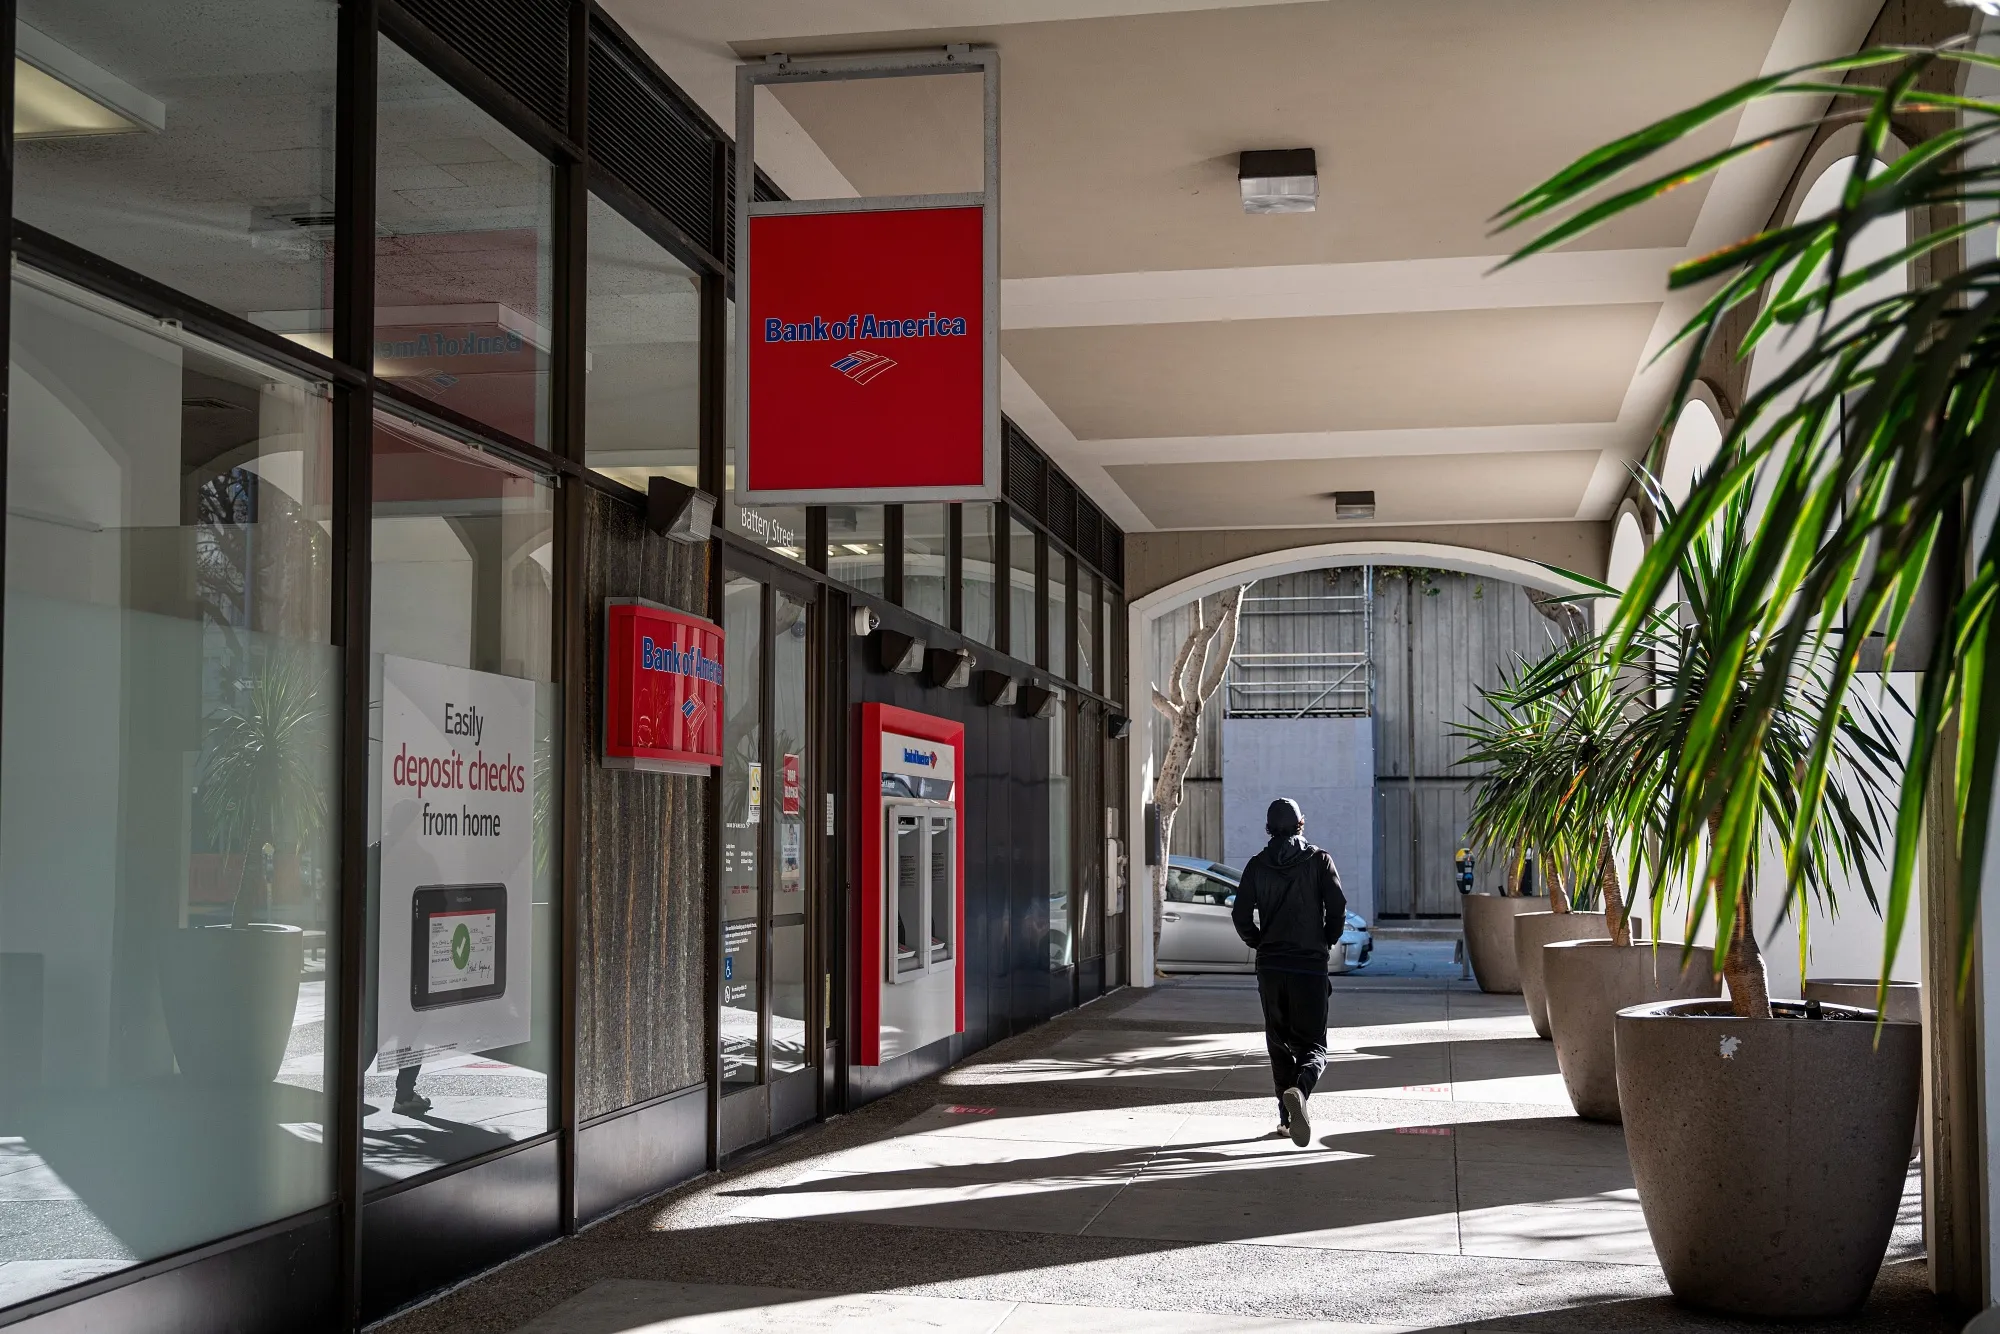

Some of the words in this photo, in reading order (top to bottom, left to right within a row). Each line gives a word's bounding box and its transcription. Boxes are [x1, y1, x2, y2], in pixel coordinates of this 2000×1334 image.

[765, 316, 829, 342] Bank
[831, 315, 859, 340] of
[860, 312, 966, 339] America
[741, 507, 770, 544] Battery
[772, 518, 795, 548] Street
[642, 635, 682, 675] Bank
[682, 646, 696, 678] of
[445, 702, 484, 746] Easily
[393, 742, 464, 798] deposit
[468, 749, 525, 793] checks
[422, 802, 458, 836] from
[462, 804, 501, 837] home
